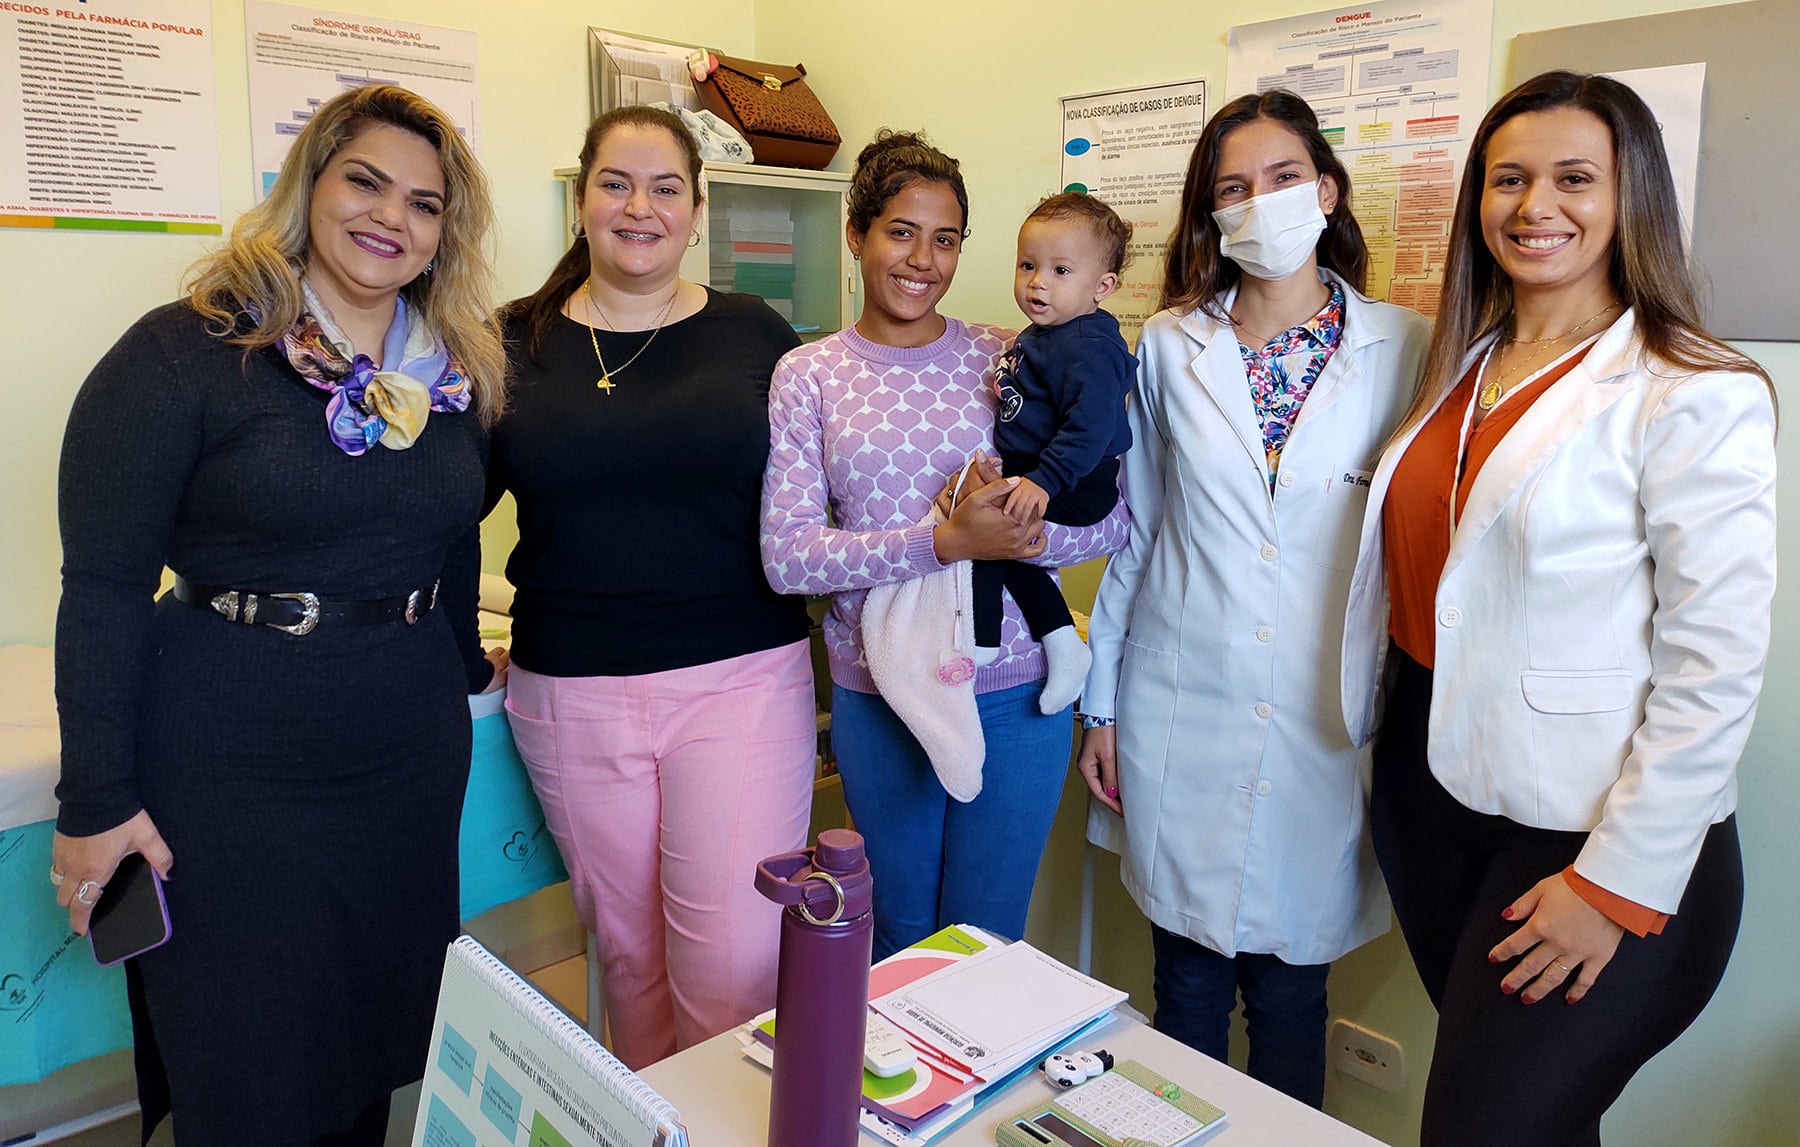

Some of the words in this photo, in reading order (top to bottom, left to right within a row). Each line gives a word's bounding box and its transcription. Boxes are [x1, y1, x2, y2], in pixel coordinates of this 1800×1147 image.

[56, 10, 86, 20] PELA
[90, 14, 149, 29] FARMÁCIA
[152, 22, 203, 36] POPULAR
[313, 18, 360, 32] SÍNDROME
[362, 26, 421, 40] GRIPAL/SRAG
[1291, 28, 1328, 38] Classificação
[1361, 20, 1383, 28] Manejo
[1394, 14, 1422, 22] Paciente
[1336, 12, 1371, 23] DENGUE
[291, 24, 338, 37] Classificação
[350, 32, 369, 41] Risco
[377, 36, 401, 47] Manejo
[412, 42, 440, 50] Paciente
[1066, 110, 1081, 120] NOVA
[1083, 102, 1128, 118] CLASSIFICAÇÃO
[1130, 102, 1137, 113] DE
[1139, 99, 1162, 112] CASOS
[1164, 98, 1172, 109] DE
[1174, 94, 1202, 107] DENGUE
[31, 946, 66, 986] HOSPITAL
[489, 1030, 510, 1058] INFECÇÕES
[510, 1050, 532, 1078] ENTÉRICAS
[537, 1075, 562, 1108] INTESTINAIS
[562, 1099, 596, 1140] SEXUALMENTE
